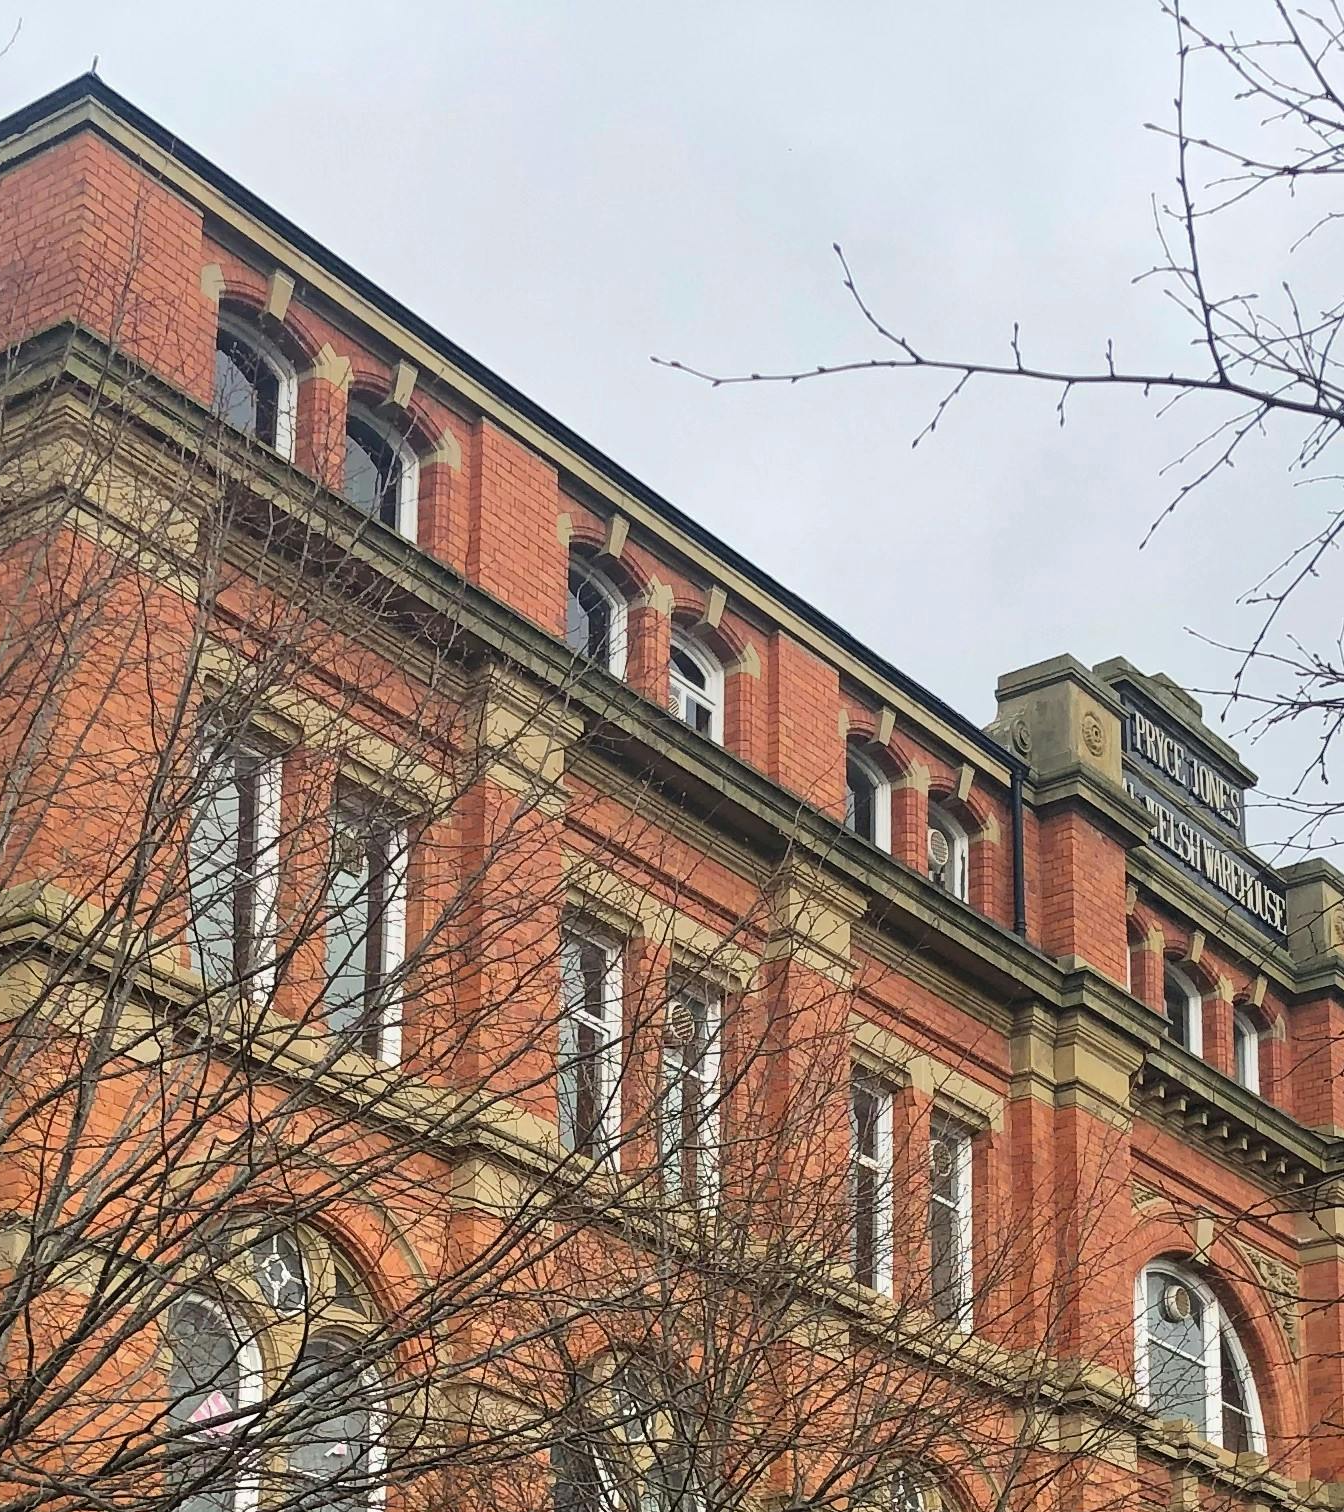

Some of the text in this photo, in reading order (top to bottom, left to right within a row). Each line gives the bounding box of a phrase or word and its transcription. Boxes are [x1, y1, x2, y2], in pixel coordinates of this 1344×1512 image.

[1135, 711, 1241, 828] PRYCE JONES
[1202, 838, 1287, 935] WAREHOUSE
